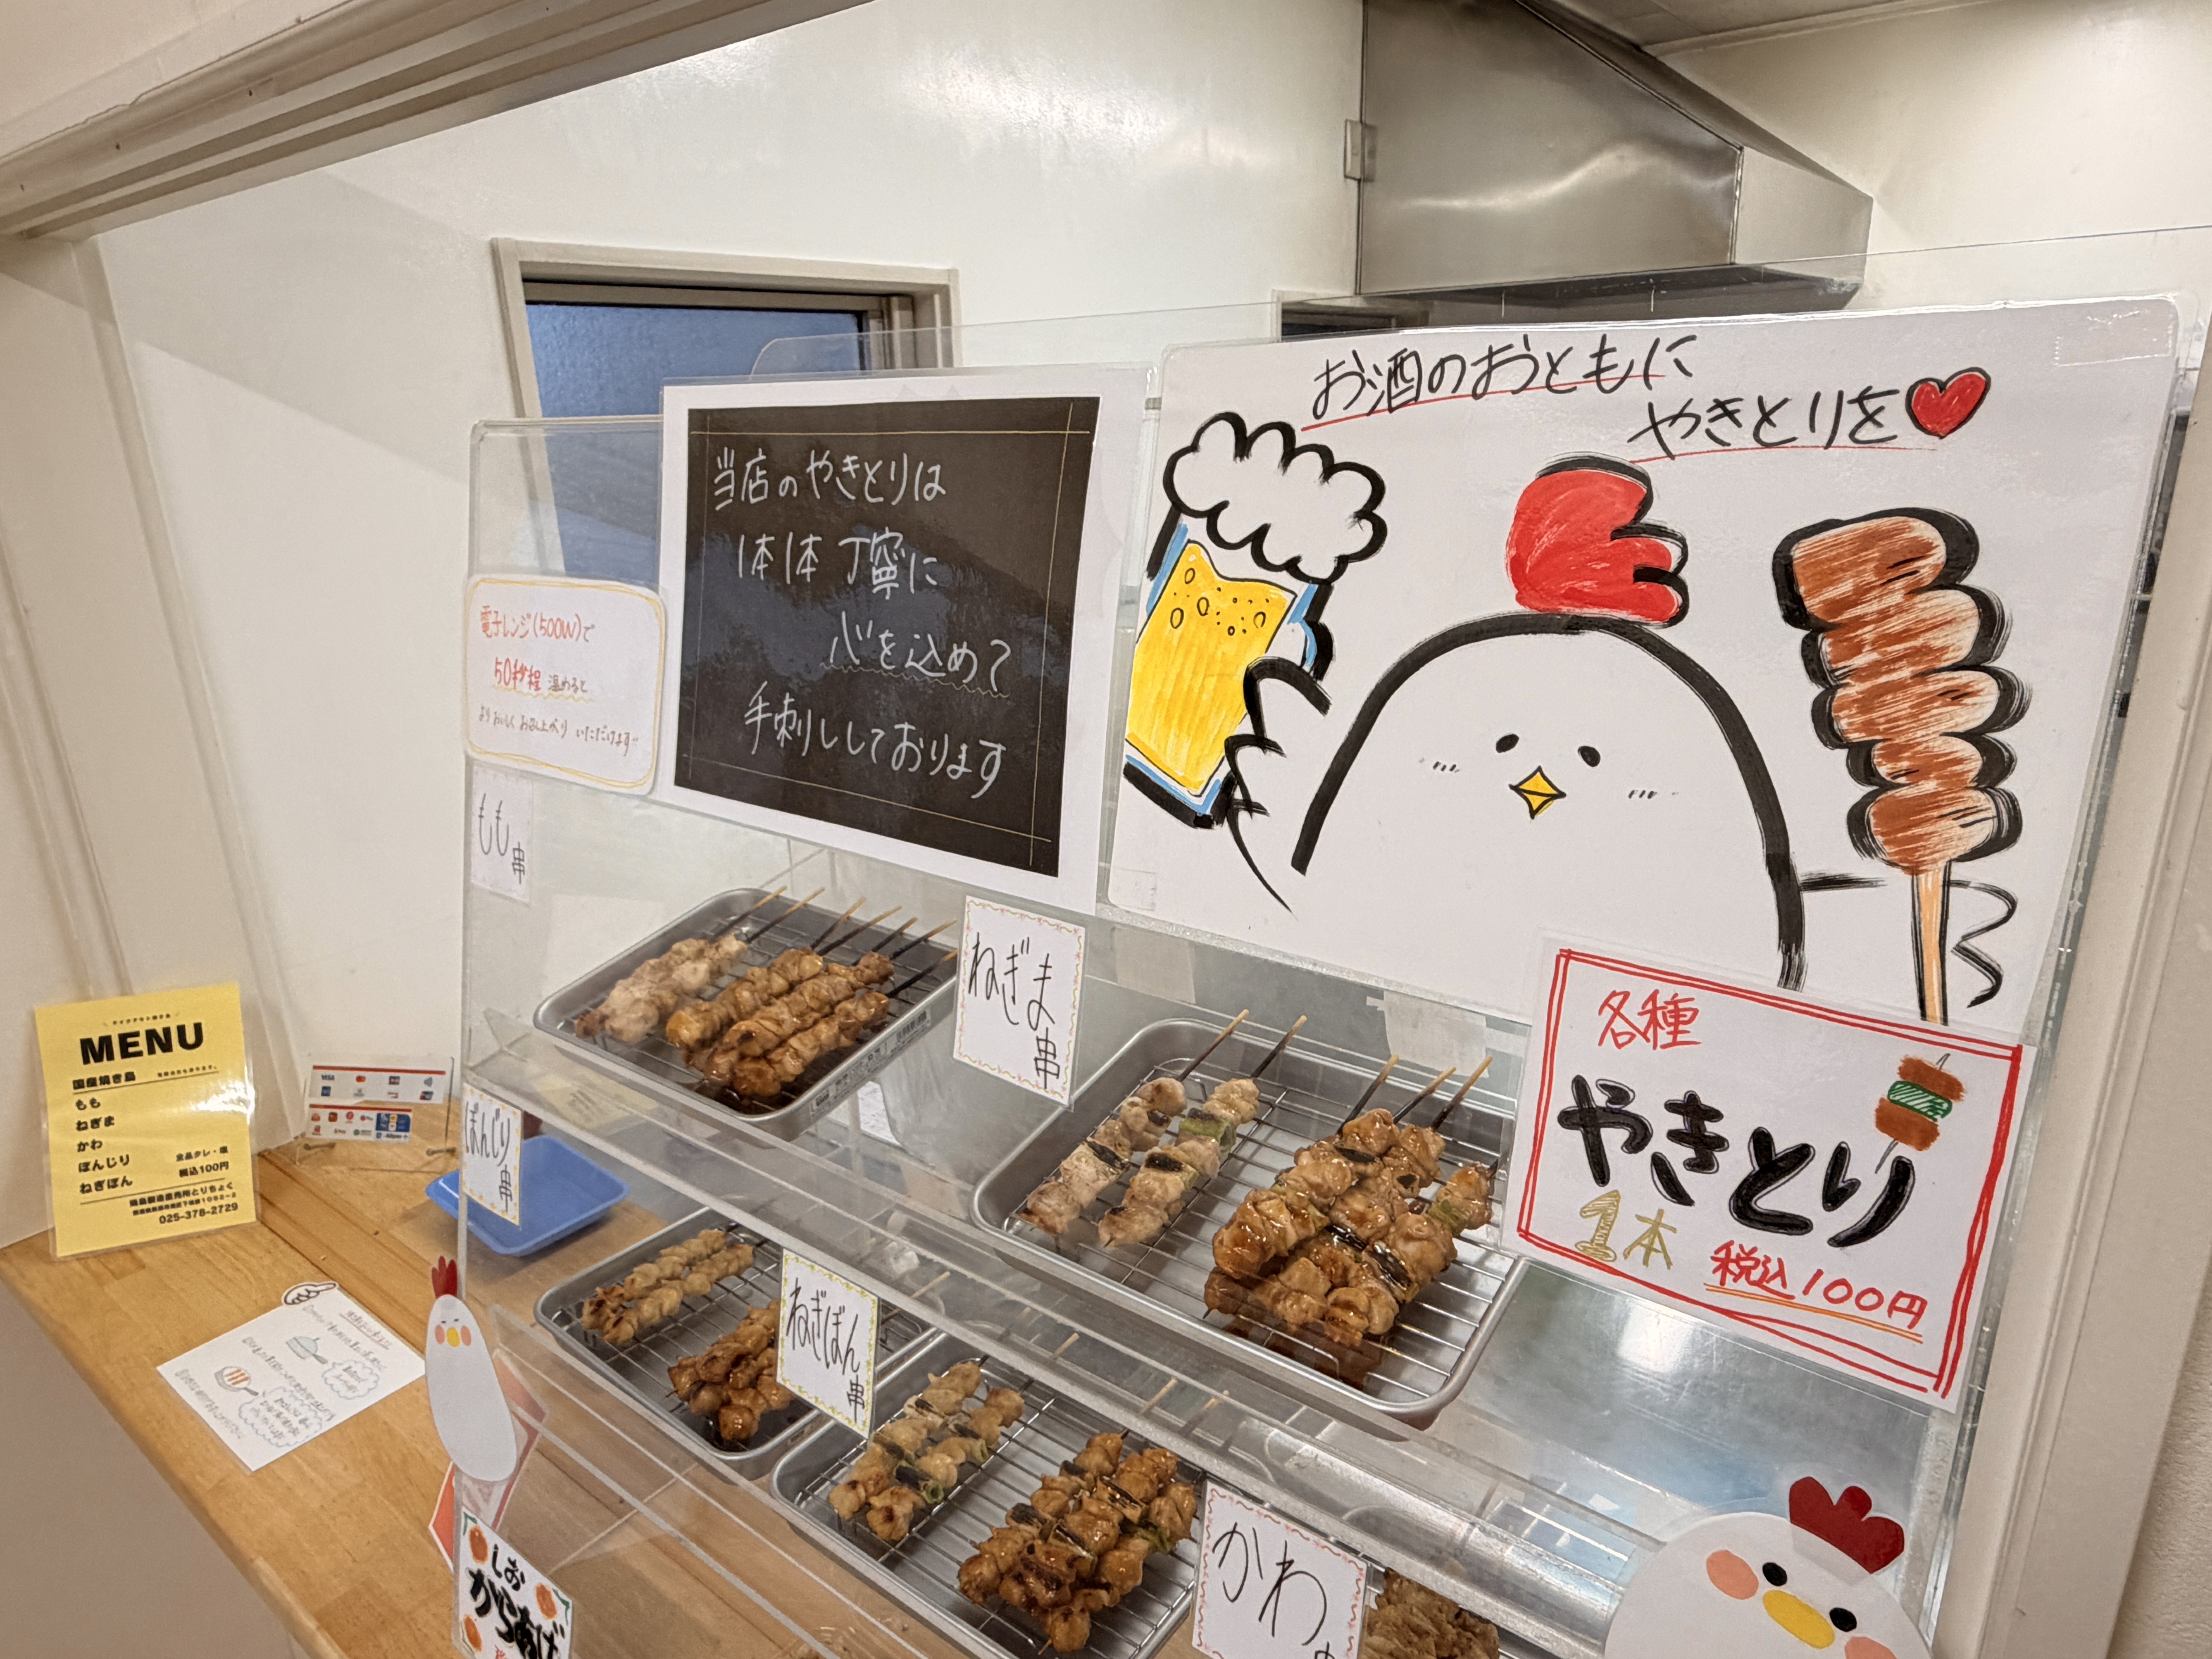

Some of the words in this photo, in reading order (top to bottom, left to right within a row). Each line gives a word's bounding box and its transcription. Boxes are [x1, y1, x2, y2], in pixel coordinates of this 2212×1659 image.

[1312, 334, 1698, 419] お酒のおともに
[1628, 386, 1900, 460] やきとりを
[714, 447, 946, 511] 当店のやきとりは
[830, 611, 1011, 692] 心を込めて
[744, 681, 1007, 799] 手刺ししております
[80, 1022, 203, 1065] MENU
[1598, 988, 1702, 1050] 各種
[75, 1097, 101, 1111] もも
[76, 1116, 115, 1132] ねぎま
[77, 1138, 103, 1153] かわ
[1557, 1074, 1917, 1248] やきとり
[1574, 1189, 1678, 1270] 1本
[1711, 1240, 1928, 1330] 税込100円
[492, 1544, 526, 1592] しお
